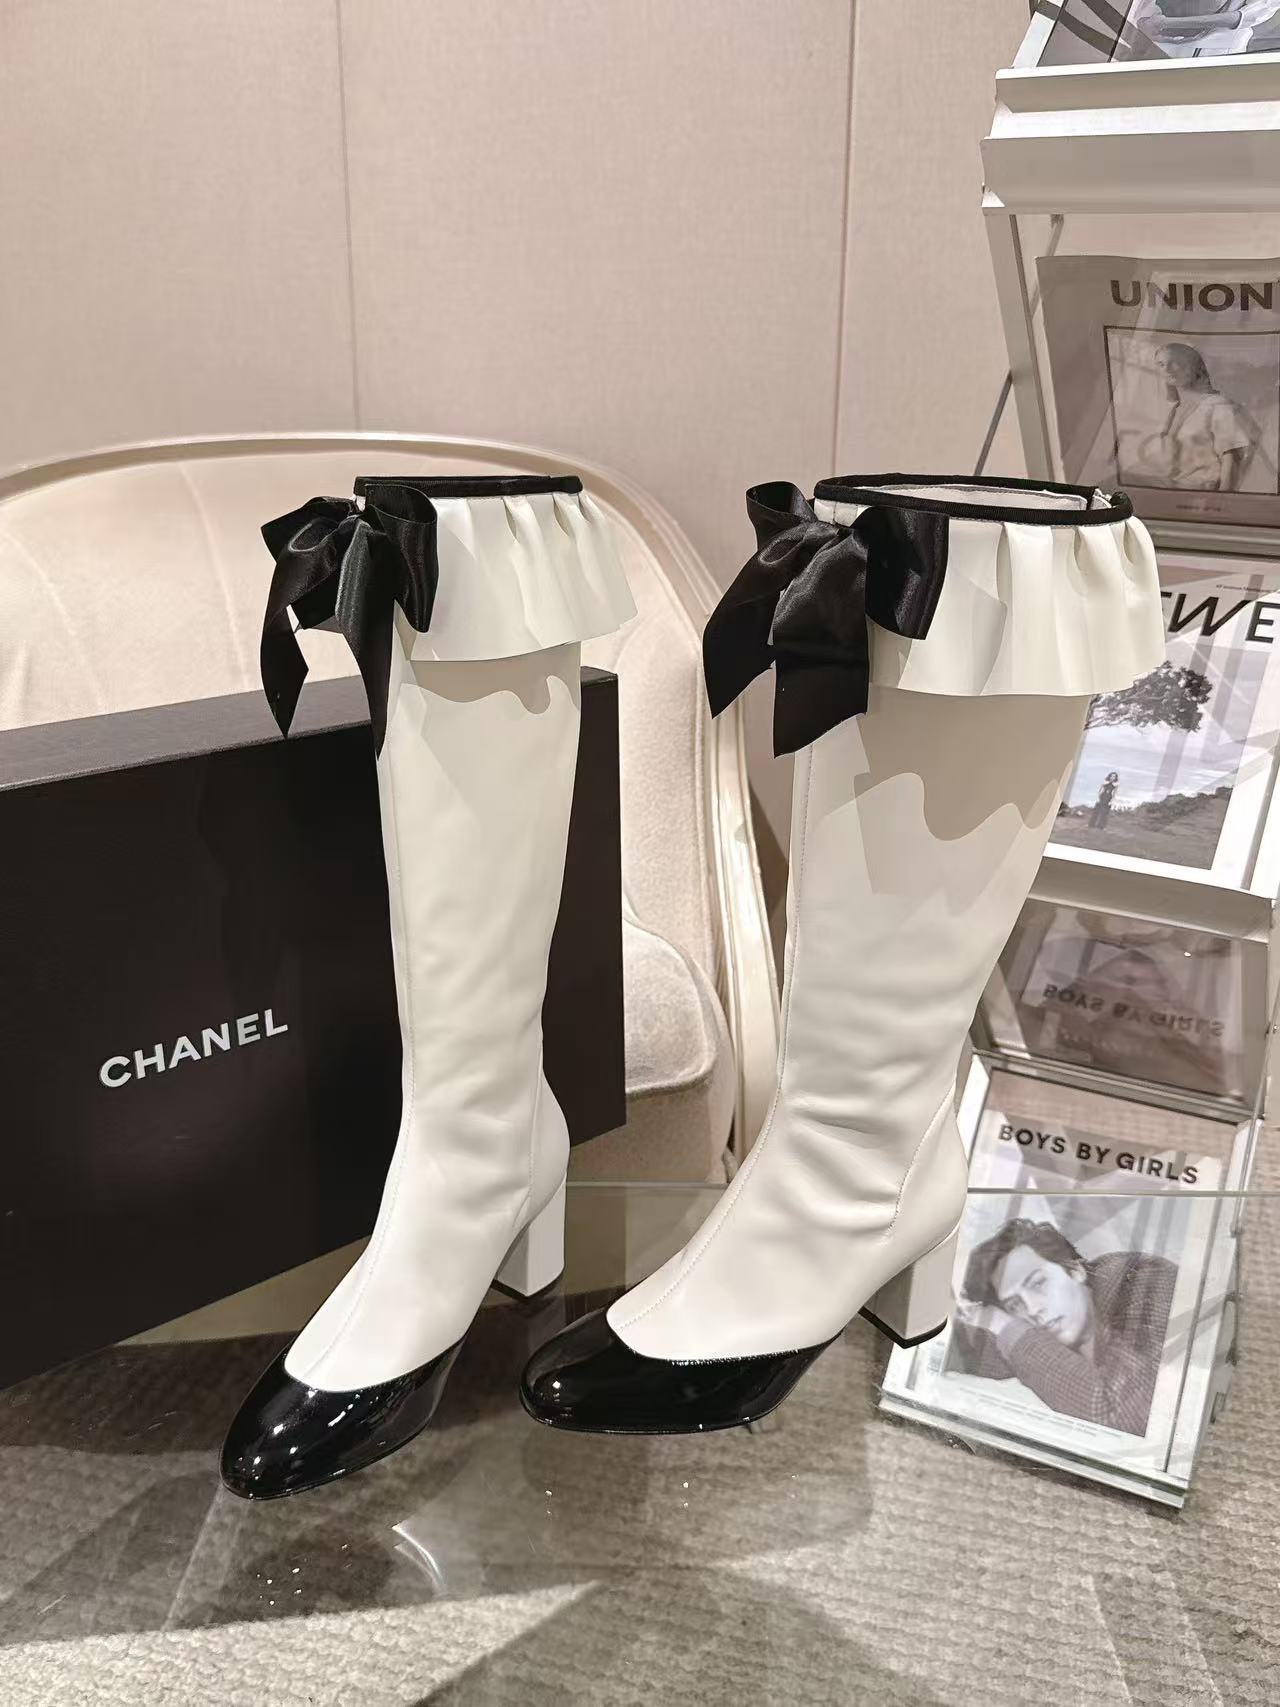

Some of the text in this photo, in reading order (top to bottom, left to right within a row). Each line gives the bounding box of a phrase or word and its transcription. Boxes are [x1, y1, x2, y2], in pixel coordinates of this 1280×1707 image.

[1110, 279, 1273, 312] UNION
[100, 1008, 289, 1088] CHANEL
[998, 1125, 1199, 1184] BOYS BY GIRLS
